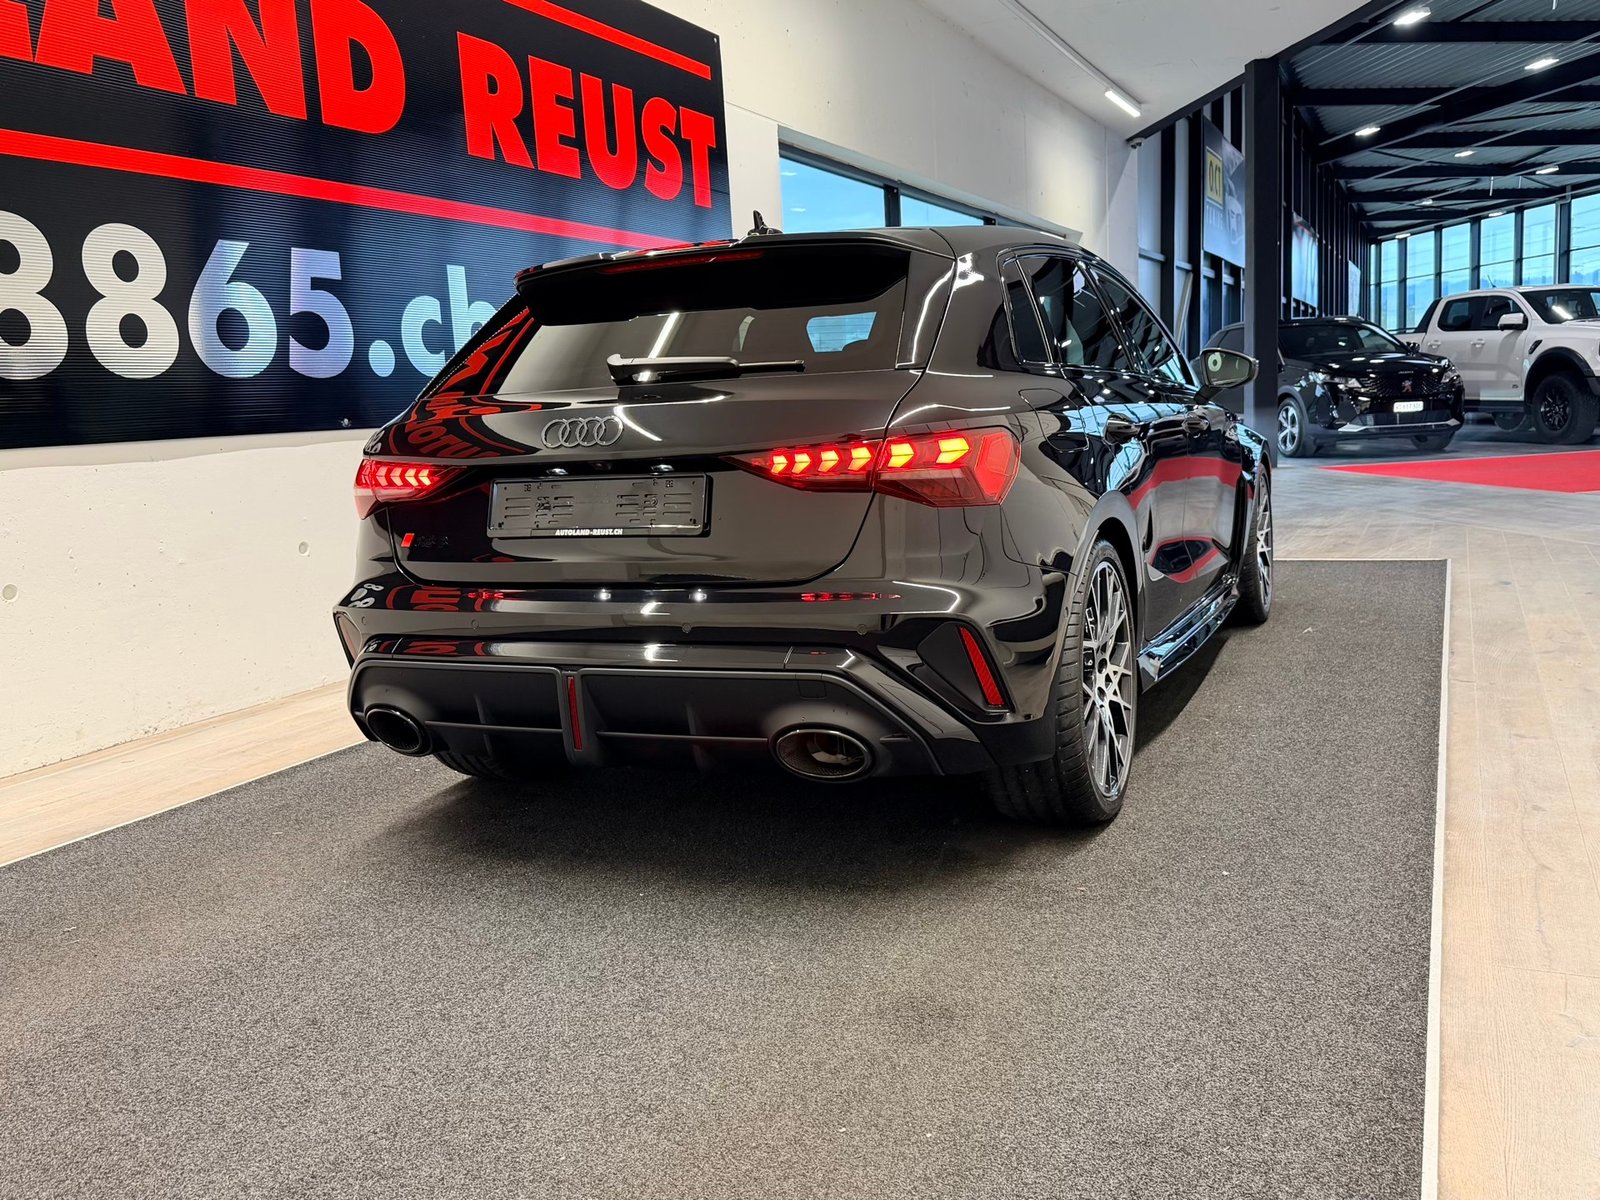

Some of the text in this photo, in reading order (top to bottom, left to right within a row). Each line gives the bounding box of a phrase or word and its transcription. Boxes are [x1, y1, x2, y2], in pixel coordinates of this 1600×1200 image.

[0, 0, 716, 208] AND REUST
[555, 528, 624, 536] AUTOLAND-REUST.CH
